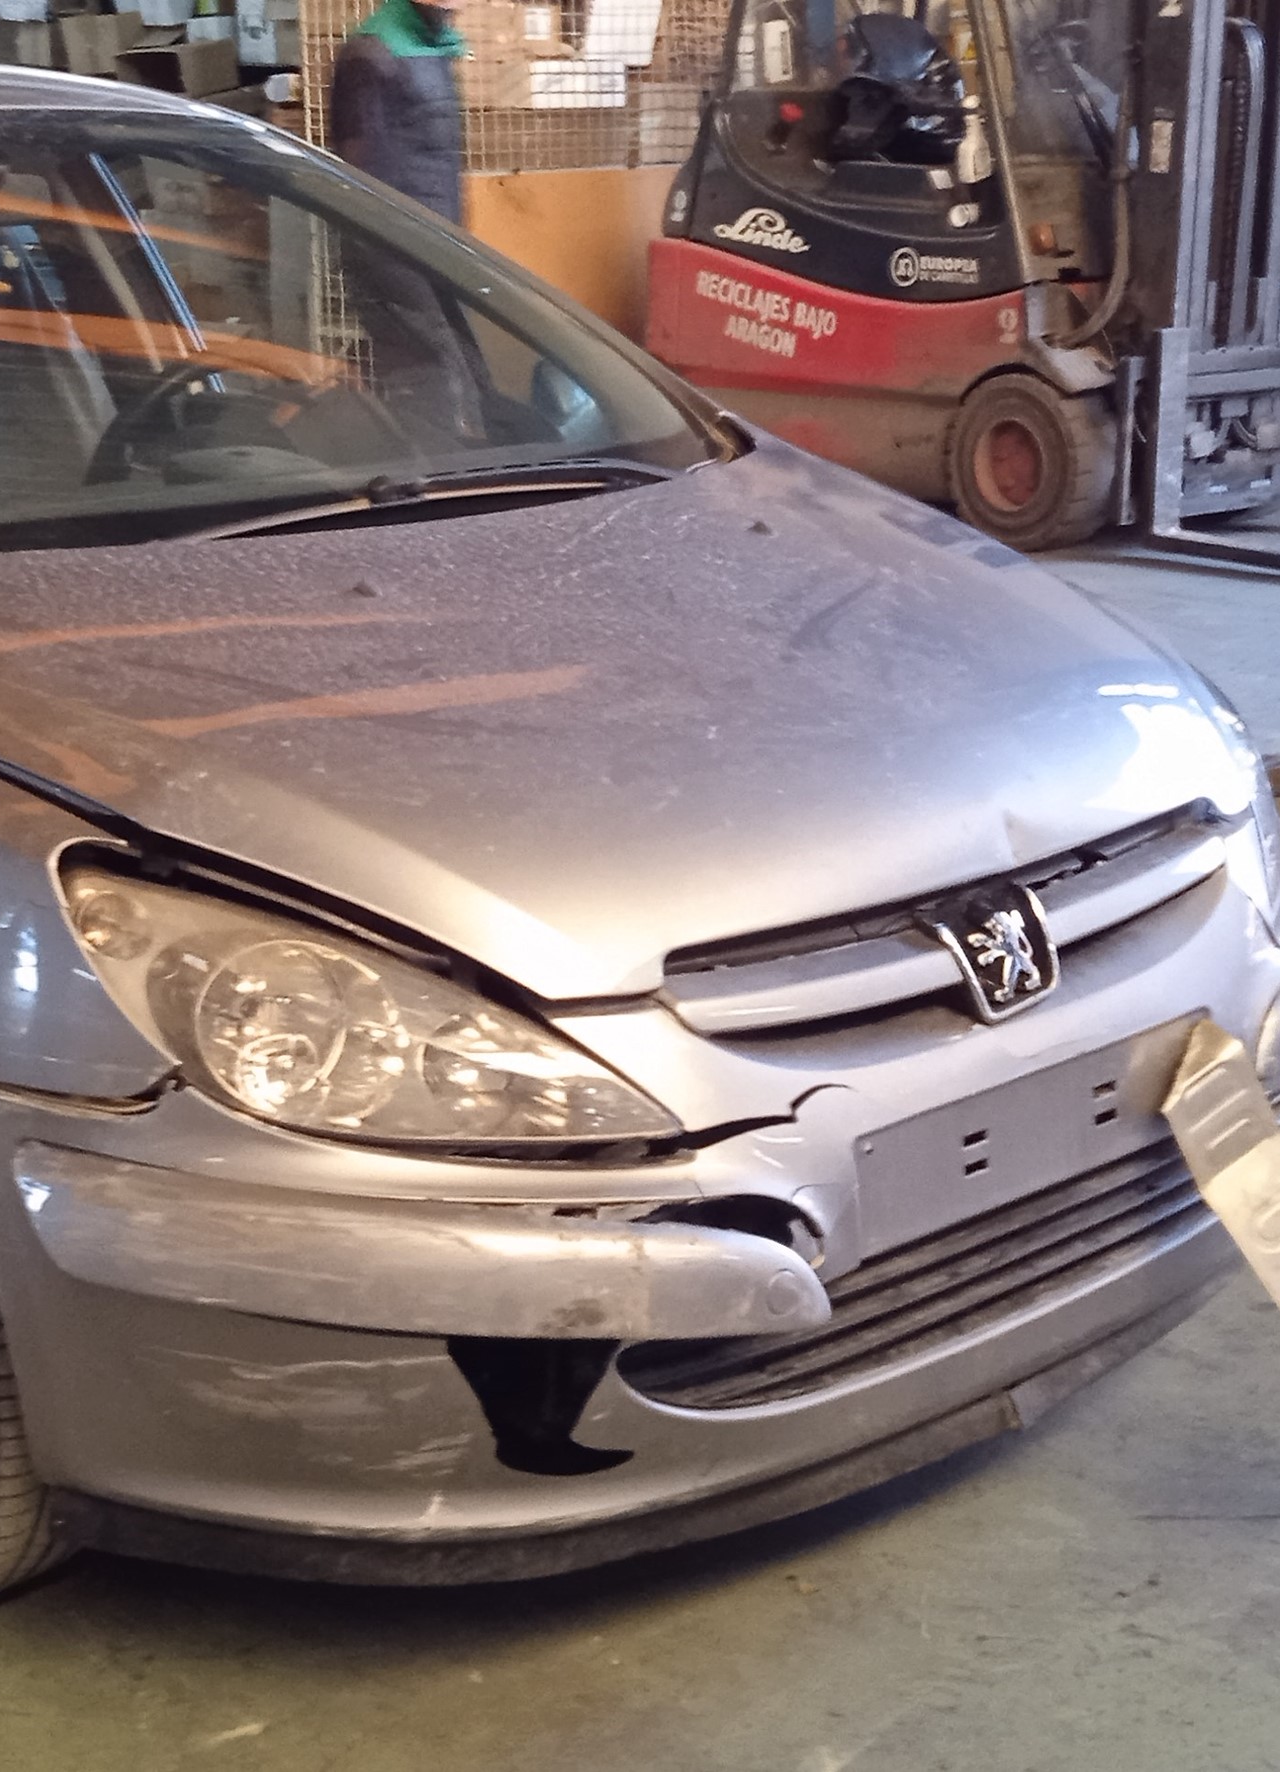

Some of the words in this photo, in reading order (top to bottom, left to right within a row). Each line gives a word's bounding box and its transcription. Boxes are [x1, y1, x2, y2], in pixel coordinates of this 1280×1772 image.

[713, 207, 811, 253] Linde
[695, 270, 791, 323] RECICLAJES
[793, 301, 838, 340] BAJO
[723, 314, 797, 359] ARAGON
